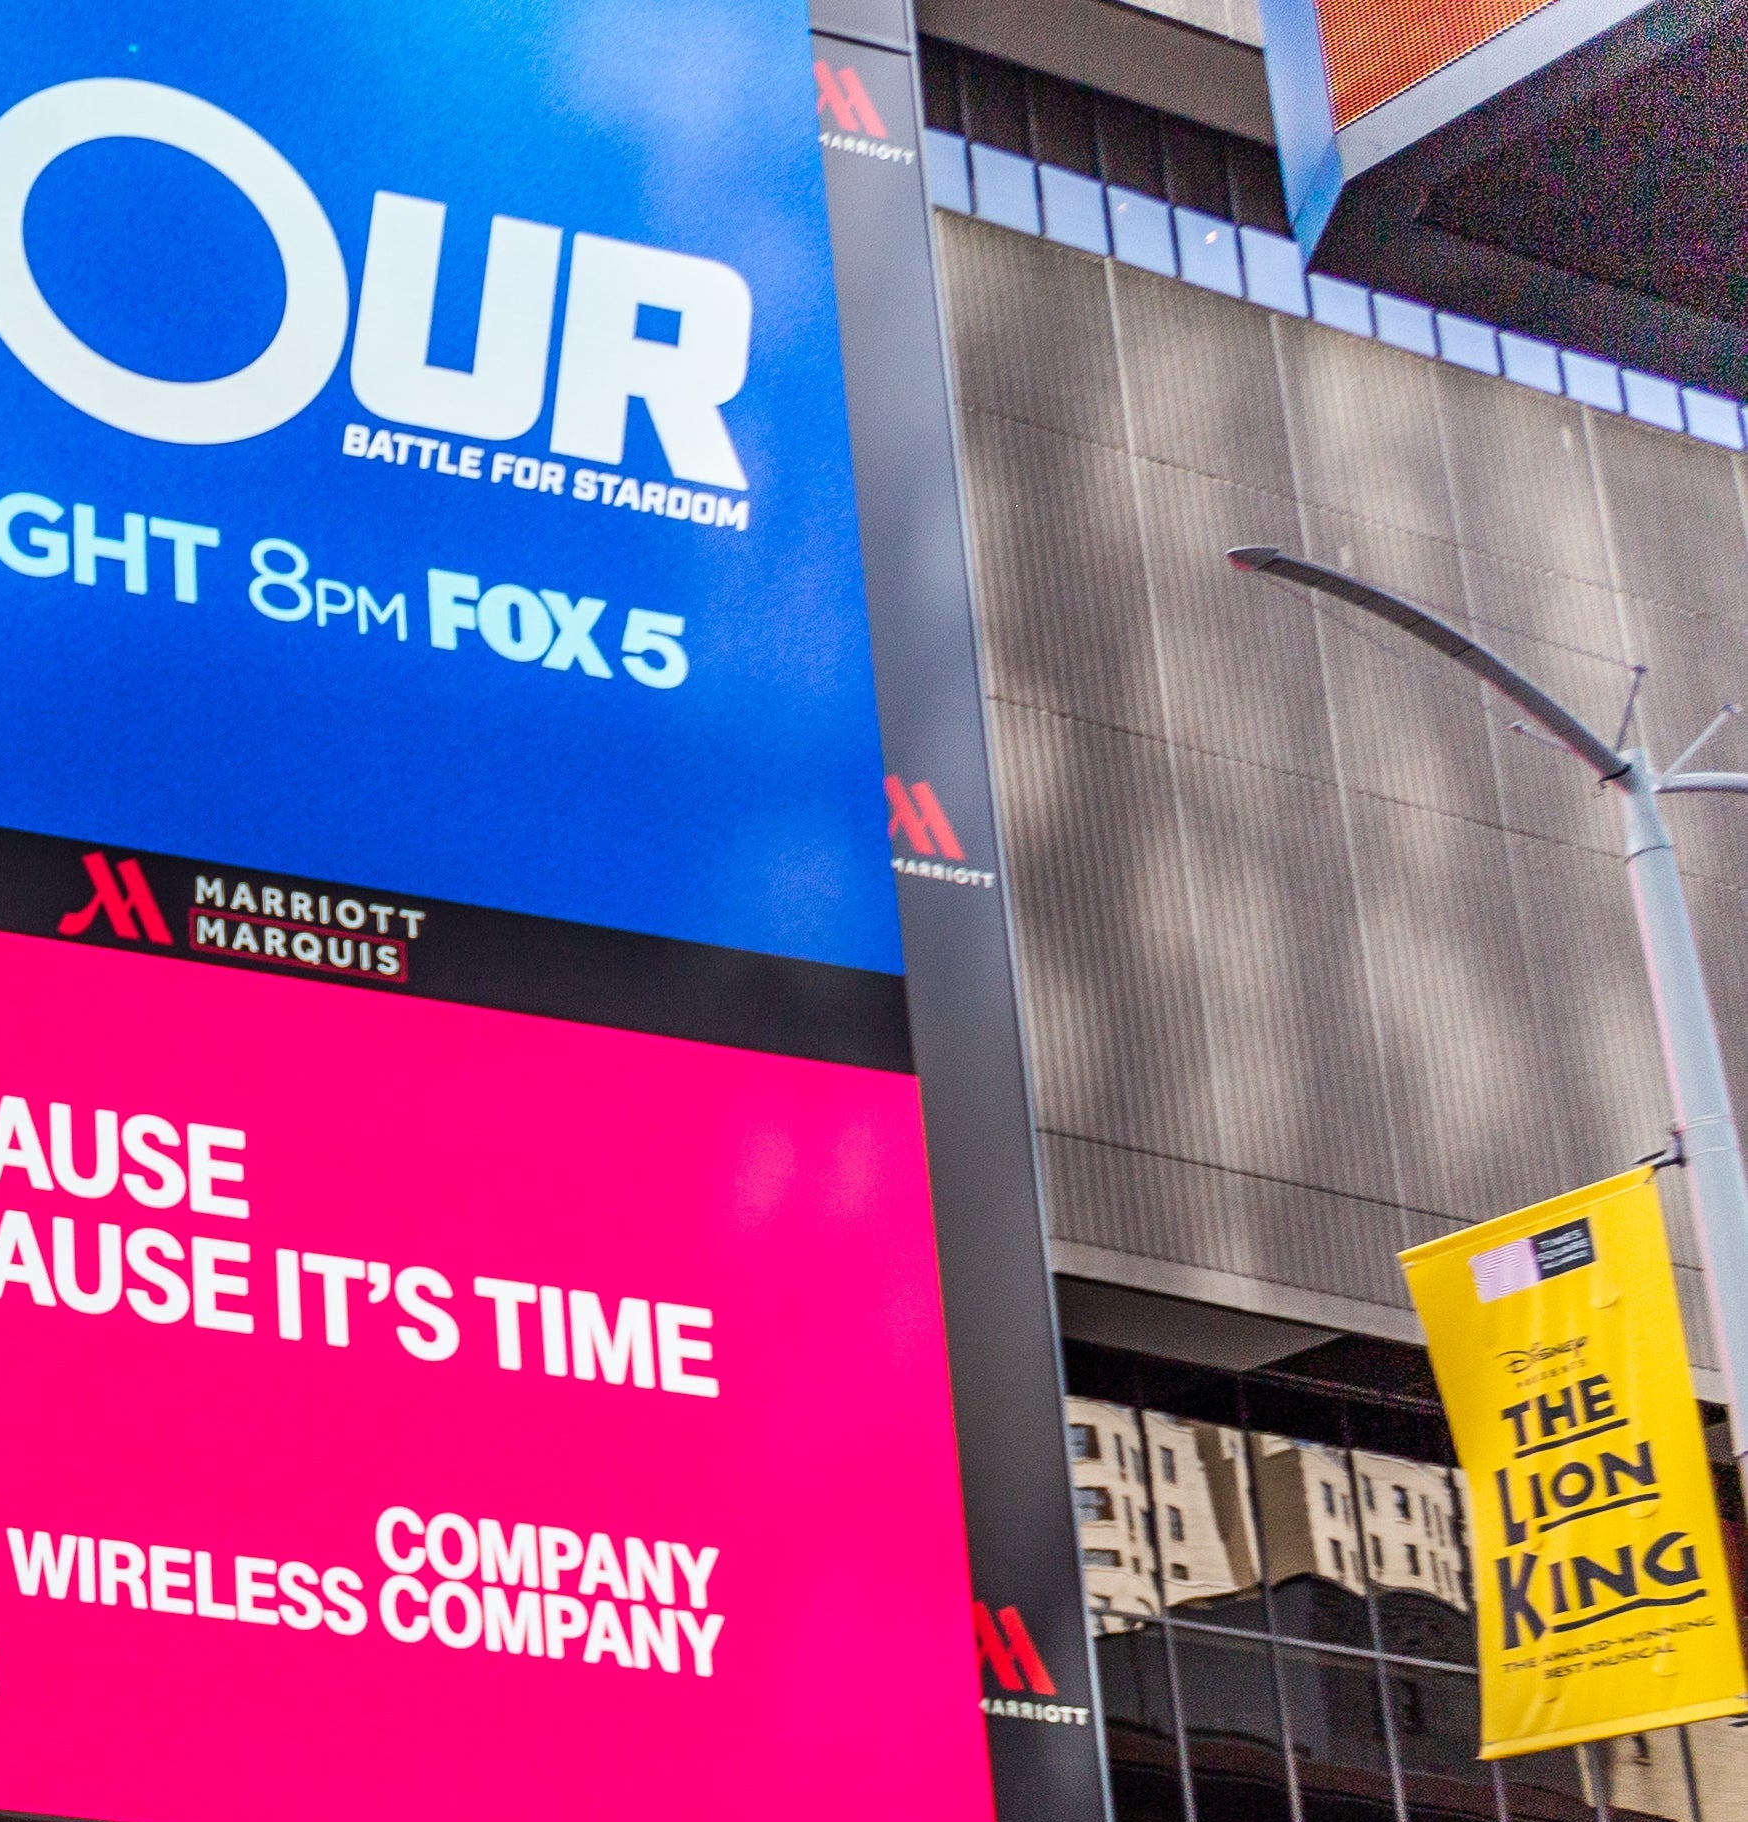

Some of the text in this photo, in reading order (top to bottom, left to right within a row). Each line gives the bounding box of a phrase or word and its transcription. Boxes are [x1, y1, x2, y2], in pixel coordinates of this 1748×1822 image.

[342, 425, 748, 530] BATTLE FOR STARDOM
[248, 538, 408, 642] 8PM
[428, 569, 613, 680] FOX
[621, 614, 688, 689] 5
[195, 875, 425, 937] MARRIOTT
[195, 917, 400, 977] MARQUIS
[276, 1247, 459, 1361] IT'S
[474, 1277, 719, 1398] TIME
[1500, 1373, 1616, 1449] THE
[1495, 1440, 1656, 1547] LION
[6, 1527, 368, 1636] WIRELESS
[379, 1574, 723, 1677] COMPANY
[375, 1505, 717, 1608] COMPANY
[1495, 1529, 1698, 1651] KING
[1501, 1616, 1717, 1673] THE AWARD-WINNING
[1545, 1643, 1676, 1679] BEST MUSICAL
